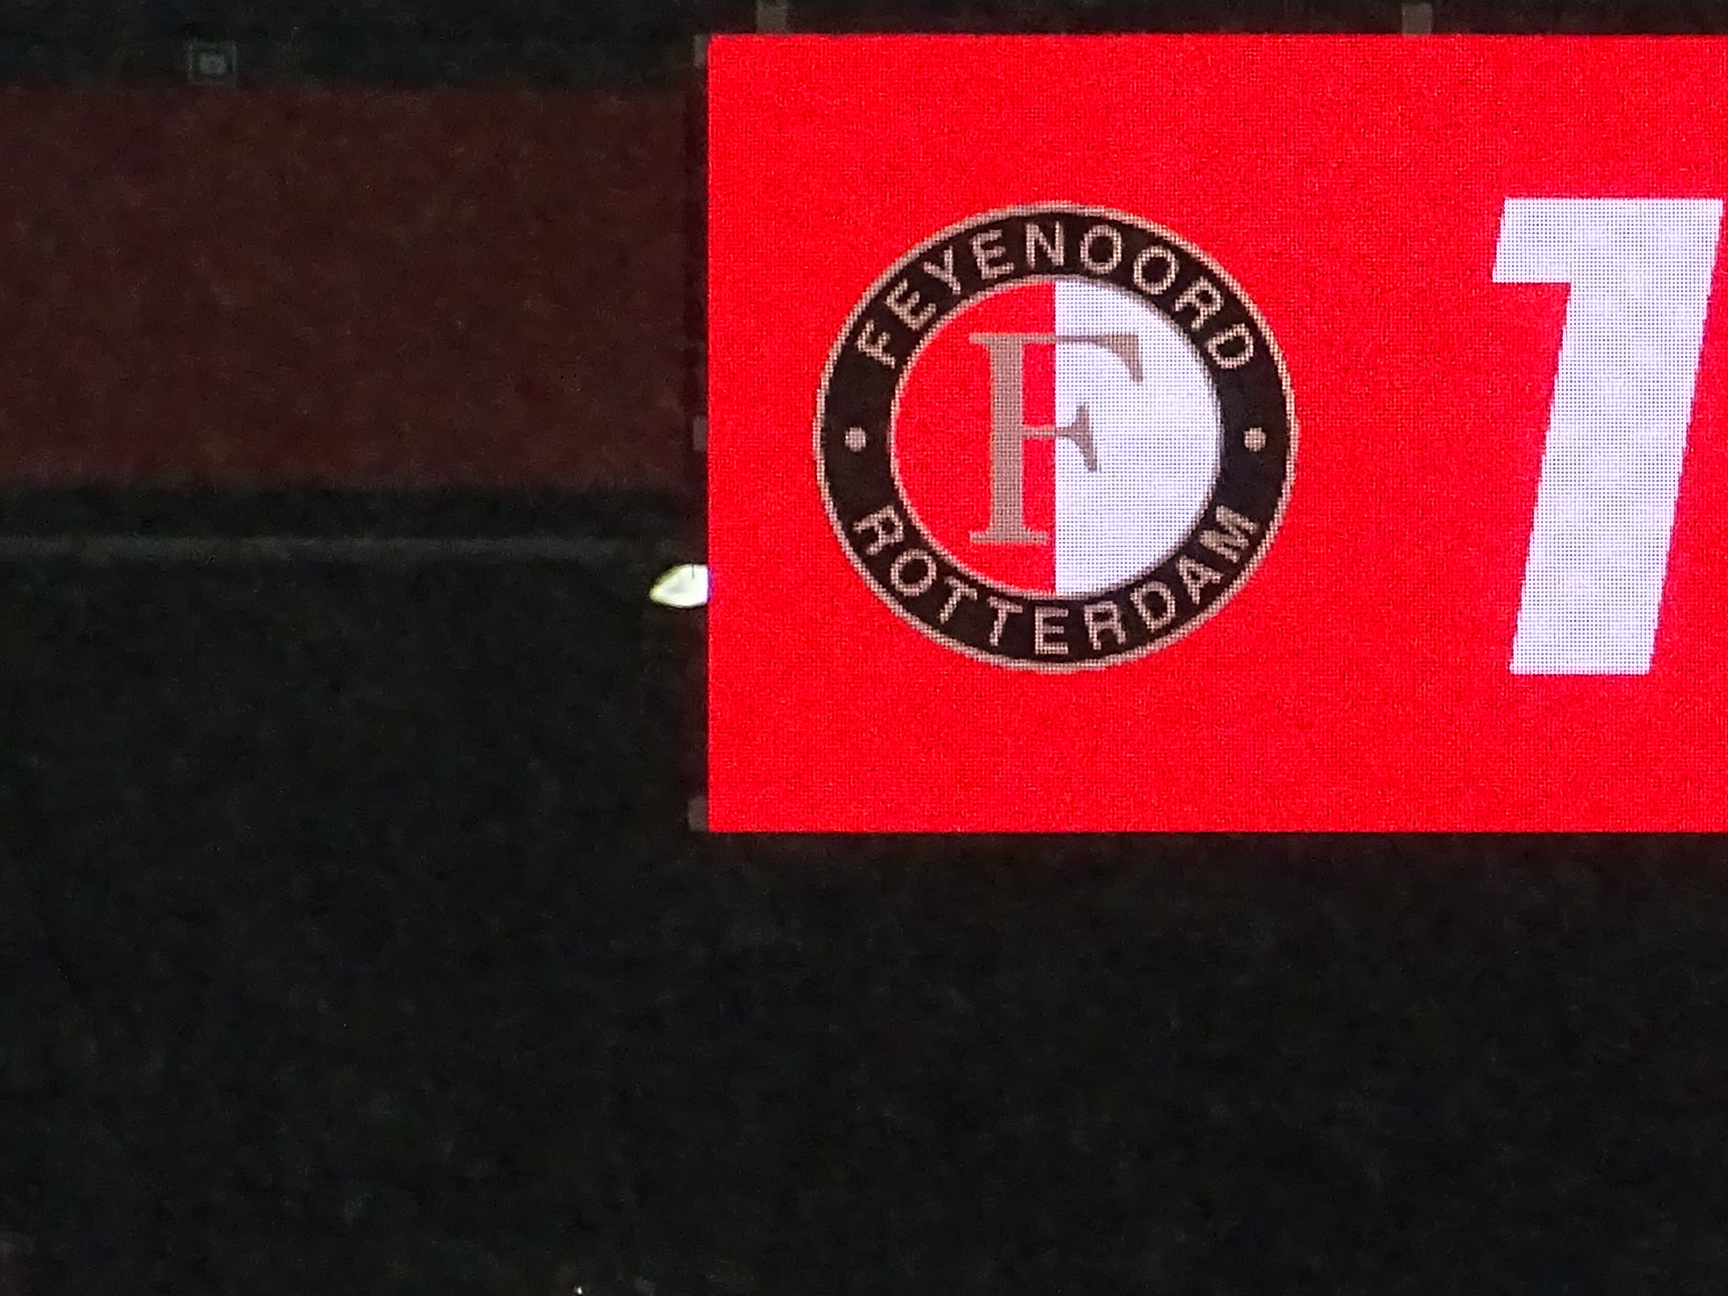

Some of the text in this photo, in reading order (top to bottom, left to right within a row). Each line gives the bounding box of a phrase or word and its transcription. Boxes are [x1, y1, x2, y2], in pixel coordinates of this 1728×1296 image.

[856, 221, 1255, 370] FEYENOORD
[968, 331, 1144, 546] F
[1492, 198, 1724, 675] 1
[852, 504, 1261, 655] ROTTERDAM
